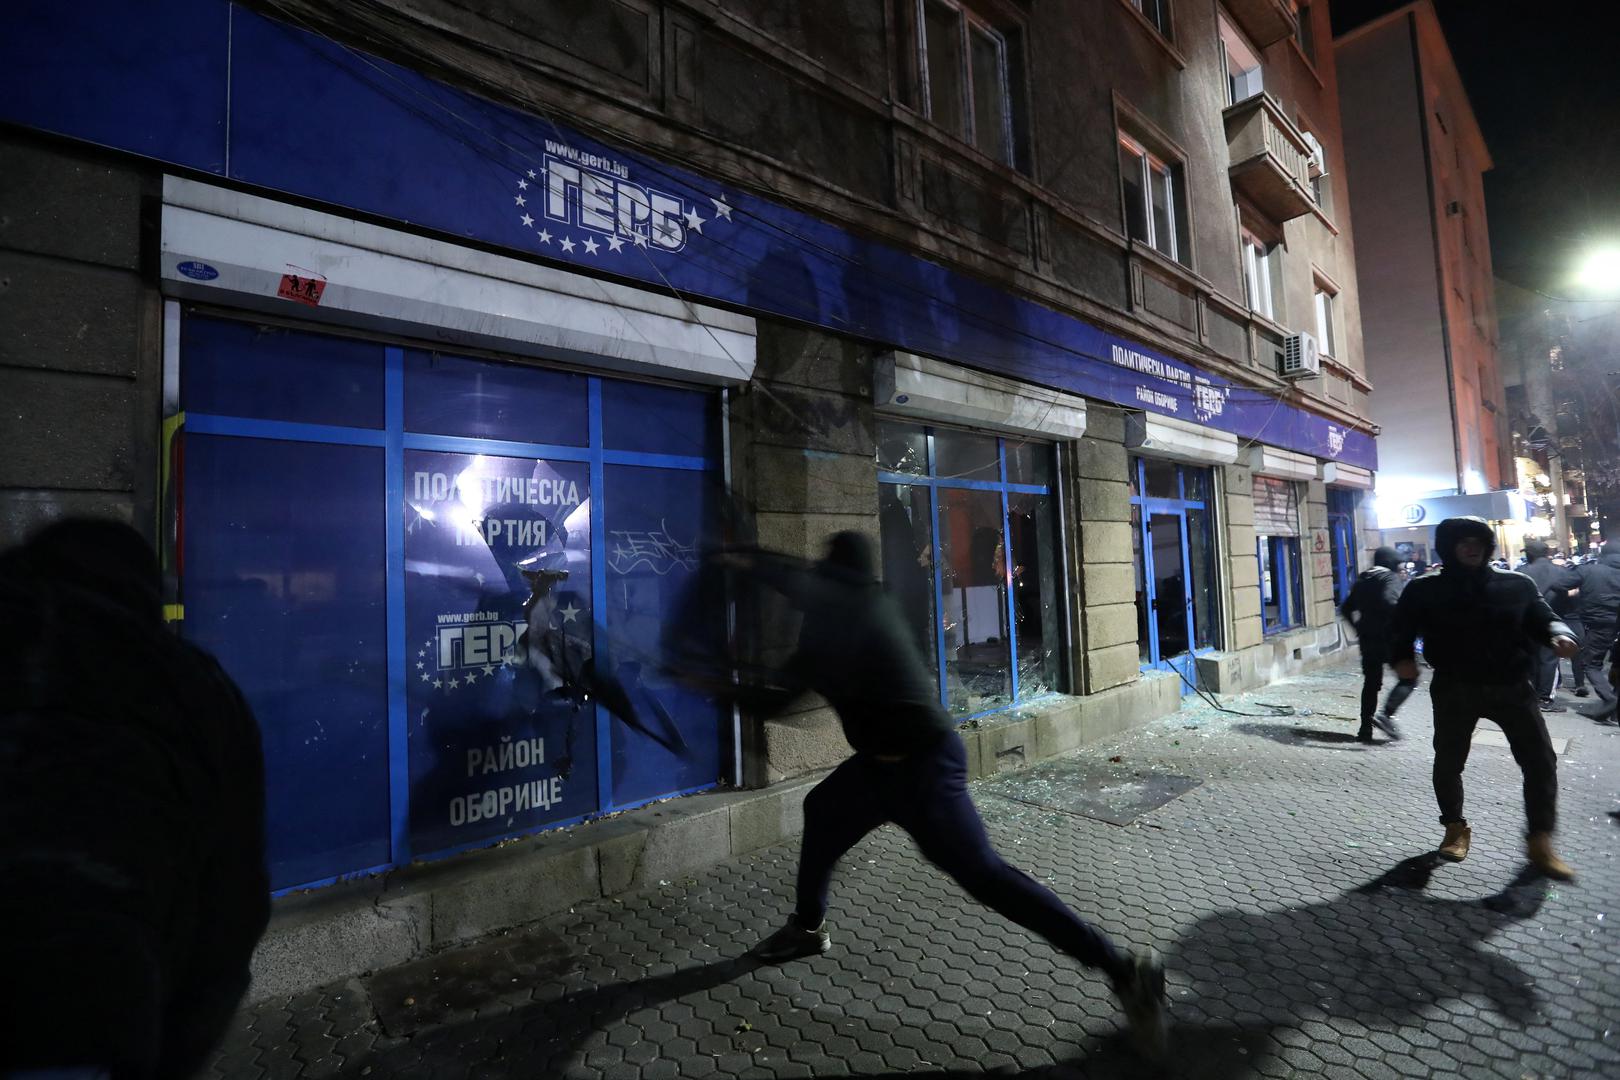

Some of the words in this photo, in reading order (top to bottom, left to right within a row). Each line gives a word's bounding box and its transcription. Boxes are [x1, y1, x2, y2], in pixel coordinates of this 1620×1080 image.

[545, 140, 628, 179] www.gerb.bg
[545, 155, 686, 251] ГЕРБ
[1112, 344, 1165, 380] ПОЛИТИЧЕСКА
[1165, 364, 1191, 389] ПАРТИЯ
[1136, 385, 1154, 405] РАЙОН
[1154, 392, 1178, 413] ОБОРИЩЕ
[1196, 384, 1223, 415] ГЕРБ
[414, 472, 580, 506] ПОЛТИЧЕСКА
[437, 611, 499, 624] www.gerb.bg
[467, 736, 545, 777] РАЙОН
[450, 776, 563, 826] ОБОРИЩЕ
